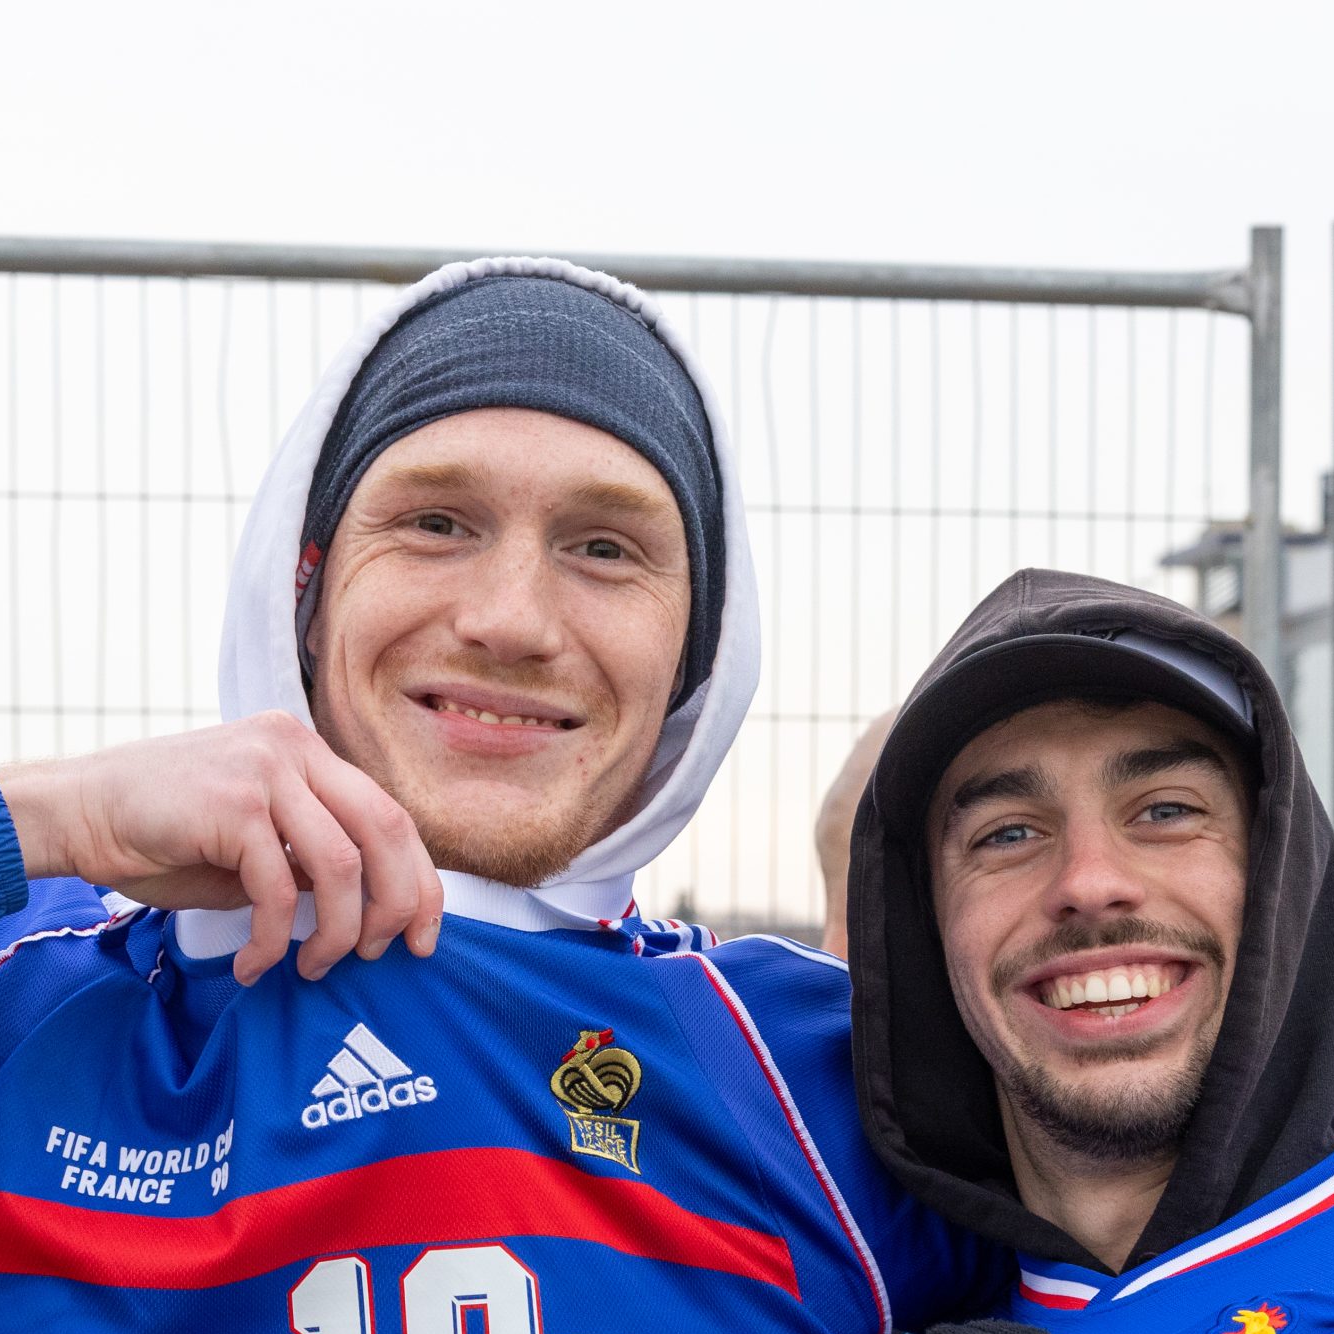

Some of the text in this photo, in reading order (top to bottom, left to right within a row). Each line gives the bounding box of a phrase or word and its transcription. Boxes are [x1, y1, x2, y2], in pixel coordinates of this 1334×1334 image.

[300, 1075, 438, 1129] adidas
[45, 1118, 235, 1176] FIFA WORLD CU
[60, 1164, 176, 1204] FRANCE
